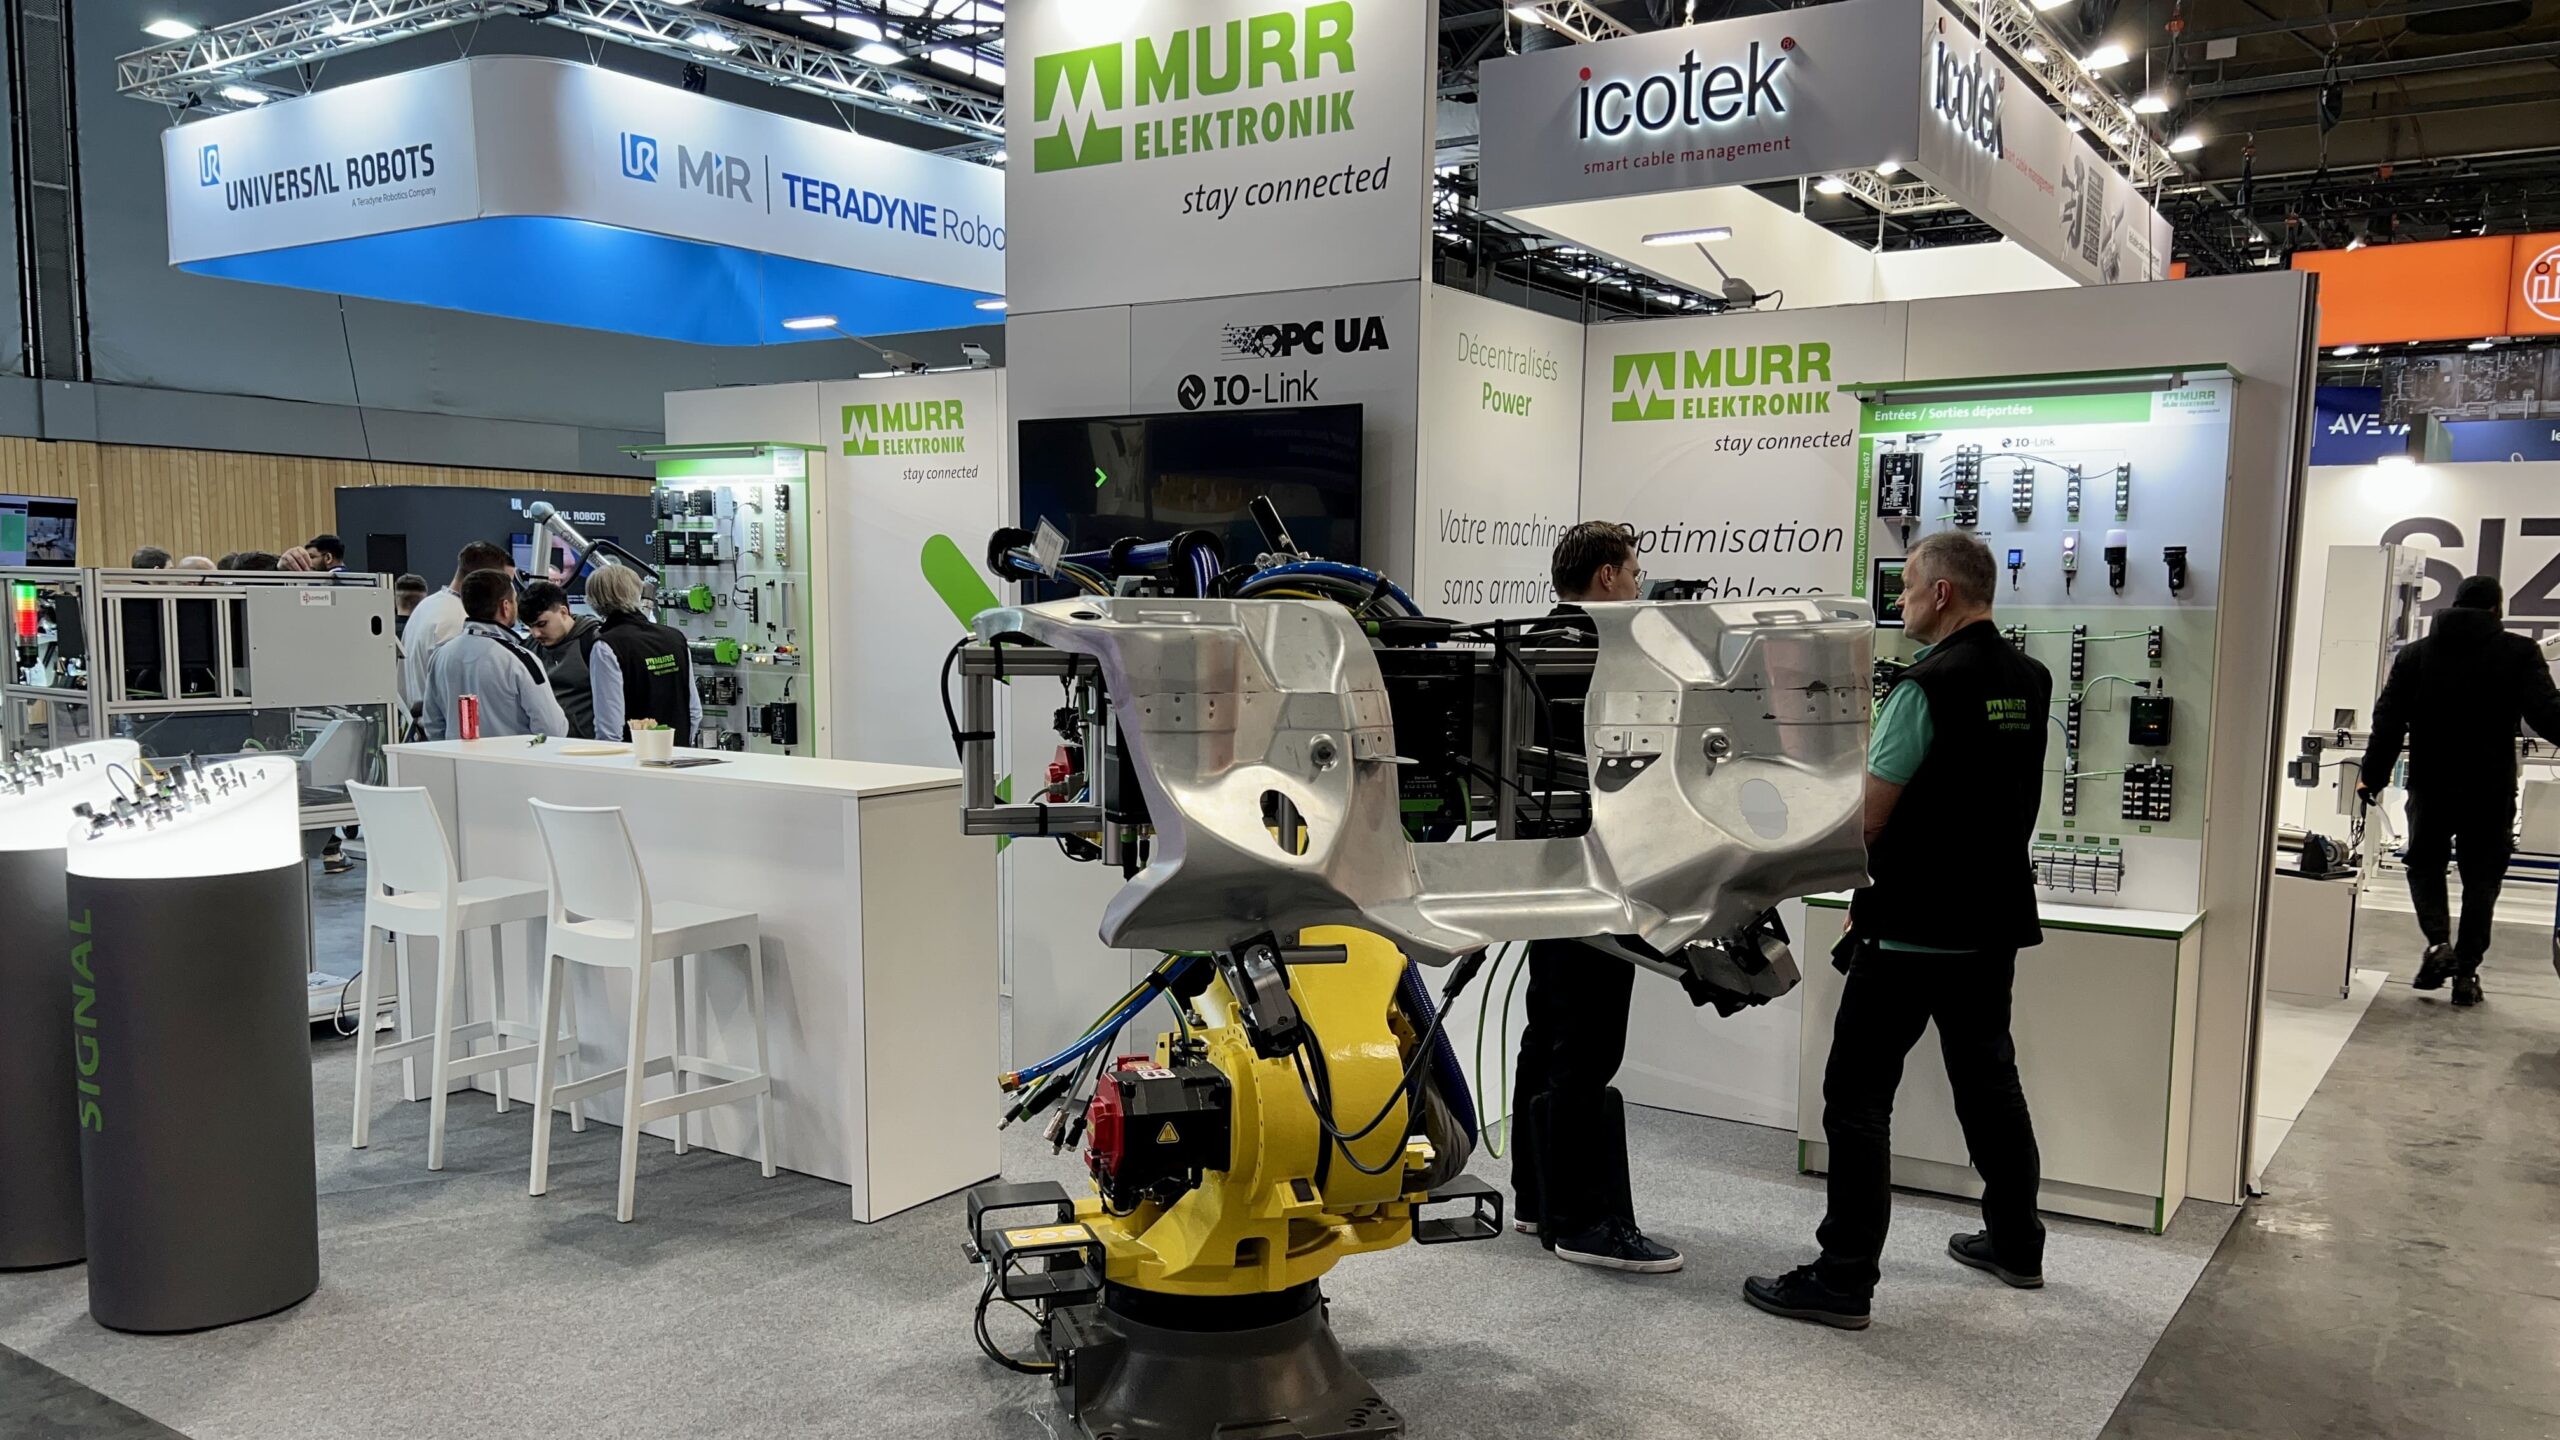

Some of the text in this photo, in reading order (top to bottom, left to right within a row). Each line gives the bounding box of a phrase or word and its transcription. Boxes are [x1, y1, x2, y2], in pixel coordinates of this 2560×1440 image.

[1135, 0, 1356, 106] MURR
[1135, 90, 1355, 161] ELEKTRONIK
[1584, 136, 1791, 175] smart cable management
[226, 143, 435, 211] UNIVERSAL ROBOTS
[1182, 156, 1391, 220] stay connected
[351, 186, 437, 208] A Teradyne Robotics Company
[782, 172, 1005, 251] TERADYNE Robo
[1253, 316, 1389, 358] OPC UA
[1457, 331, 1559, 382] Décentralisés
[1682, 342, 1831, 389] MURR
[1214, 369, 1319, 406] IO-Link
[1482, 382, 1532, 418] Power
[1682, 391, 1831, 420] ELEKTRONIK
[2179, 390, 2216, 401] MURR
[881, 399, 964, 433] MURR
[1874, 403, 2034, 422] Entrées / Sorties déportées
[883, 436, 966, 455] ELEKTRONIK
[1714, 429, 1853, 456] stay connected
[903, 465, 979, 484] stay connected
[573, 511, 606, 522] ROBOTS
[1440, 508, 1487, 545] Votre
[1856, 451, 1871, 590] SOLUTION COMPACTE Impact67
[1442, 572, 1557, 605] sans armoire
[69, 908, 103, 1133] SIGNAL
